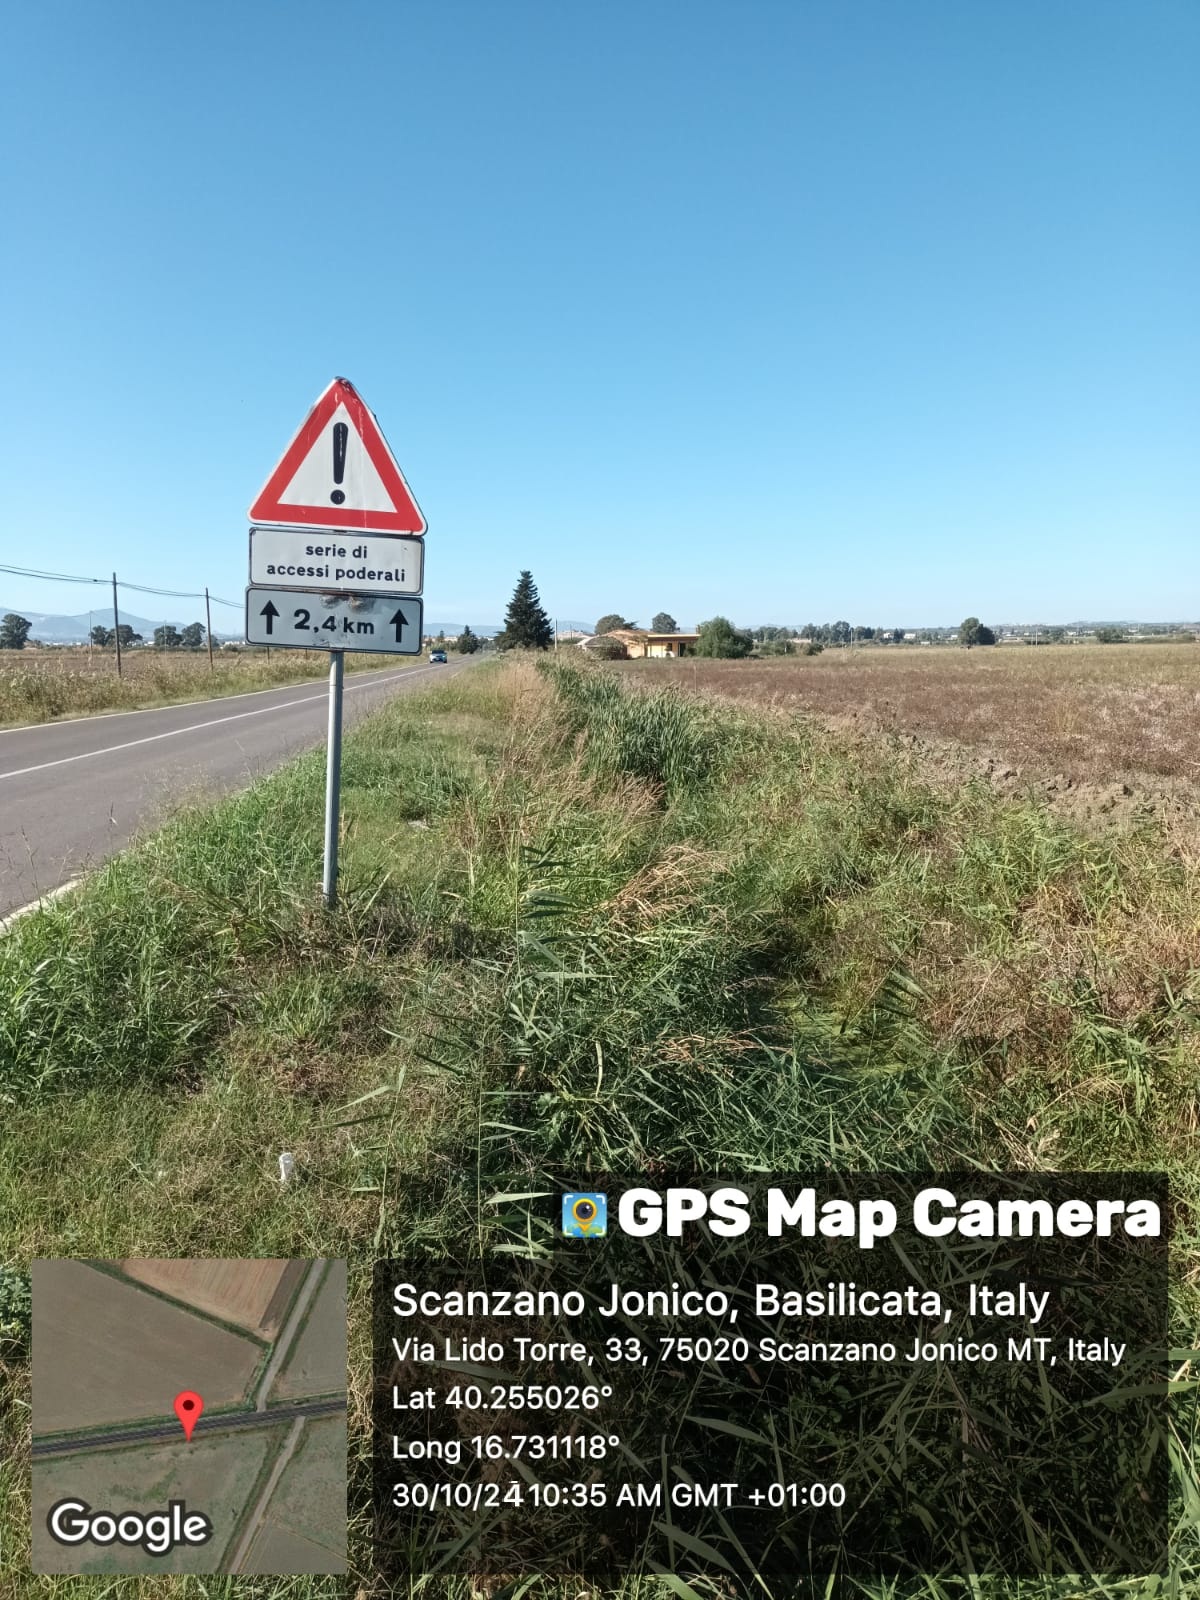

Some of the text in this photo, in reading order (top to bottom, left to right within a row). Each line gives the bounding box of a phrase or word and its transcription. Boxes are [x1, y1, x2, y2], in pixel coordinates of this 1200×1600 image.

[305, 543, 368, 559] serie di
[266, 563, 406, 583] accessi poderali
[293, 609, 375, 635] 2,4 km
